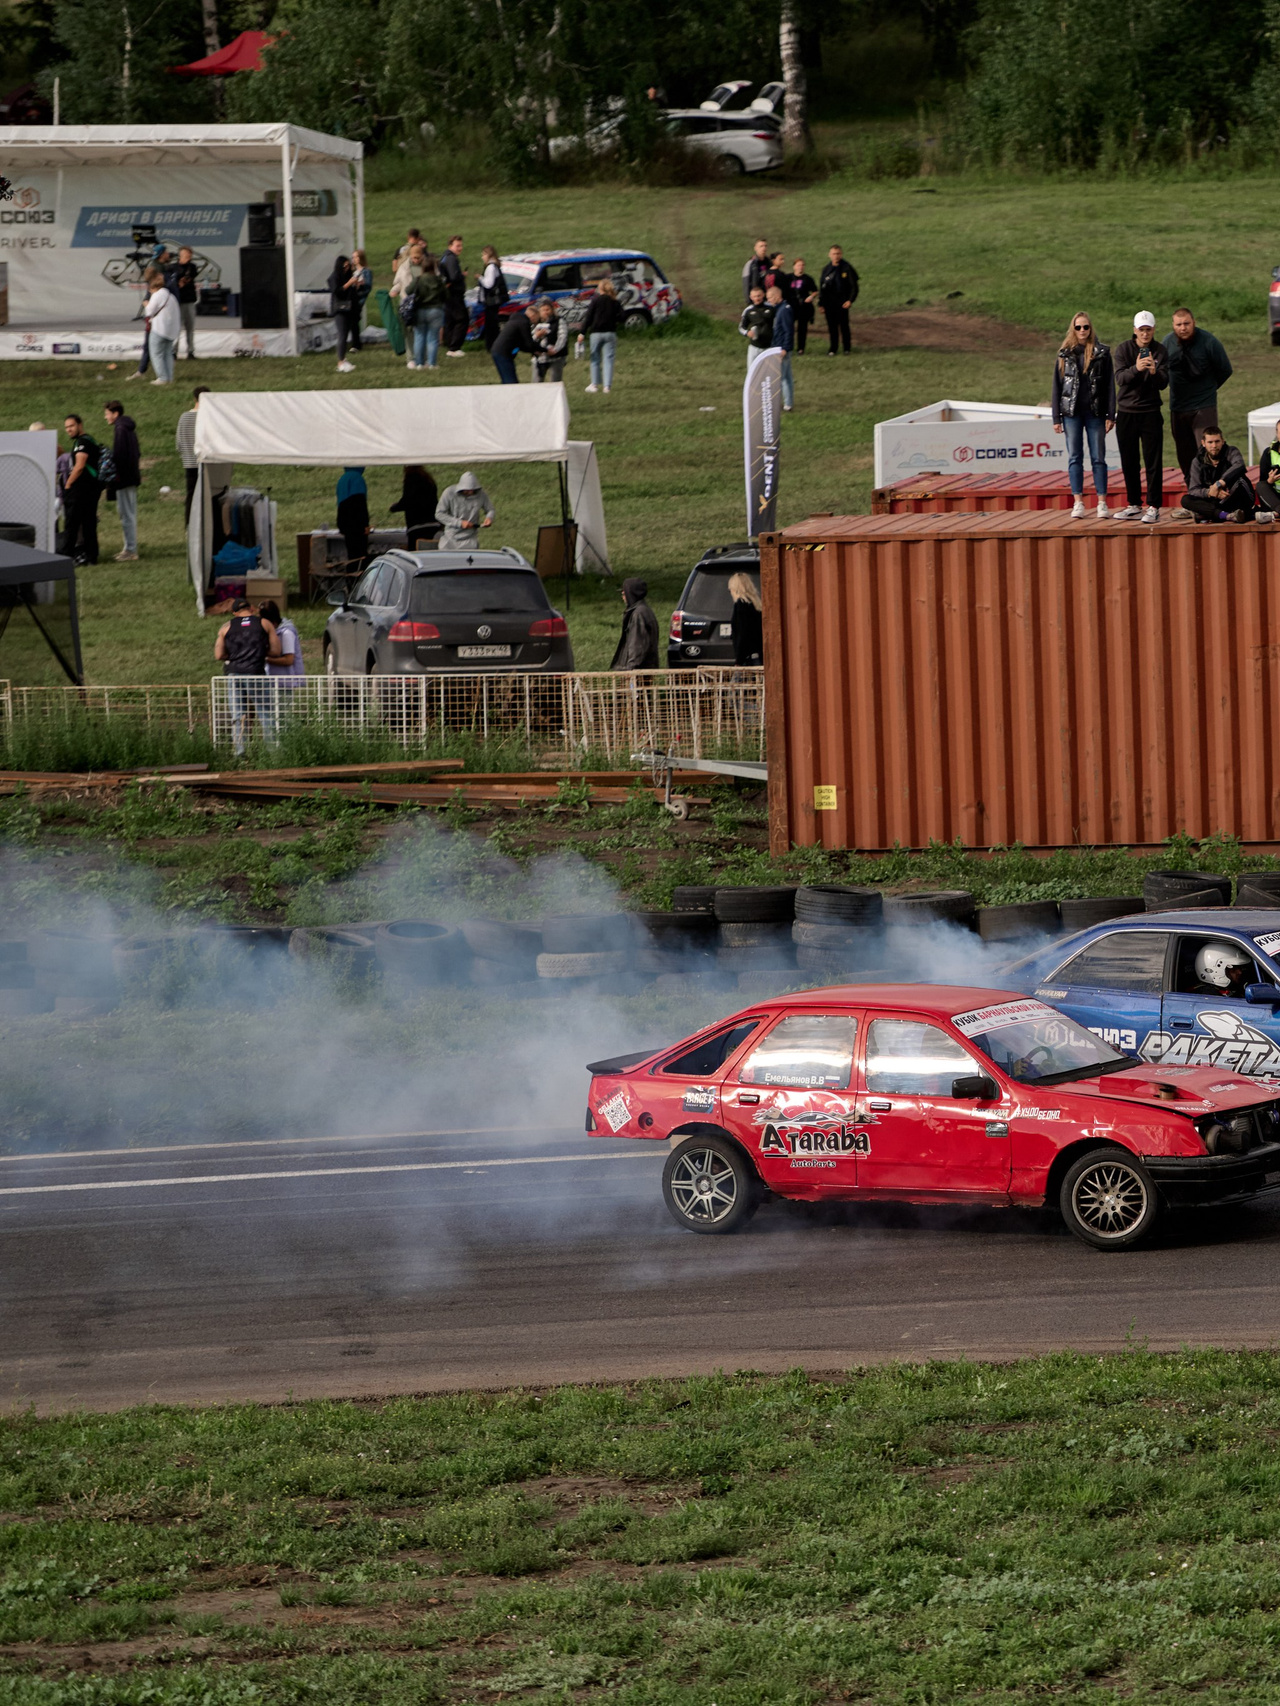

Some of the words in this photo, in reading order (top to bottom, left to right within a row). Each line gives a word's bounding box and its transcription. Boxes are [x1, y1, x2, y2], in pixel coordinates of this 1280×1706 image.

[0, 211, 55, 224] СОЮЗ
[86, 211, 137, 226] ДРИФТ
[140, 212, 149, 224] В
[154, 210, 231, 223] БАРНАУЛЕ
[976, 448, 1017, 459] СОЮЗ
[764, 453, 774, 498] DENT
[953, 1013, 981, 1027] КУБОК
[978, 1003, 1031, 1020] БАРНАУЛЬСКОЙ
[765, 1073, 809, 1084] Емельянов
[790, 1160, 836, 1168] AutoParts
